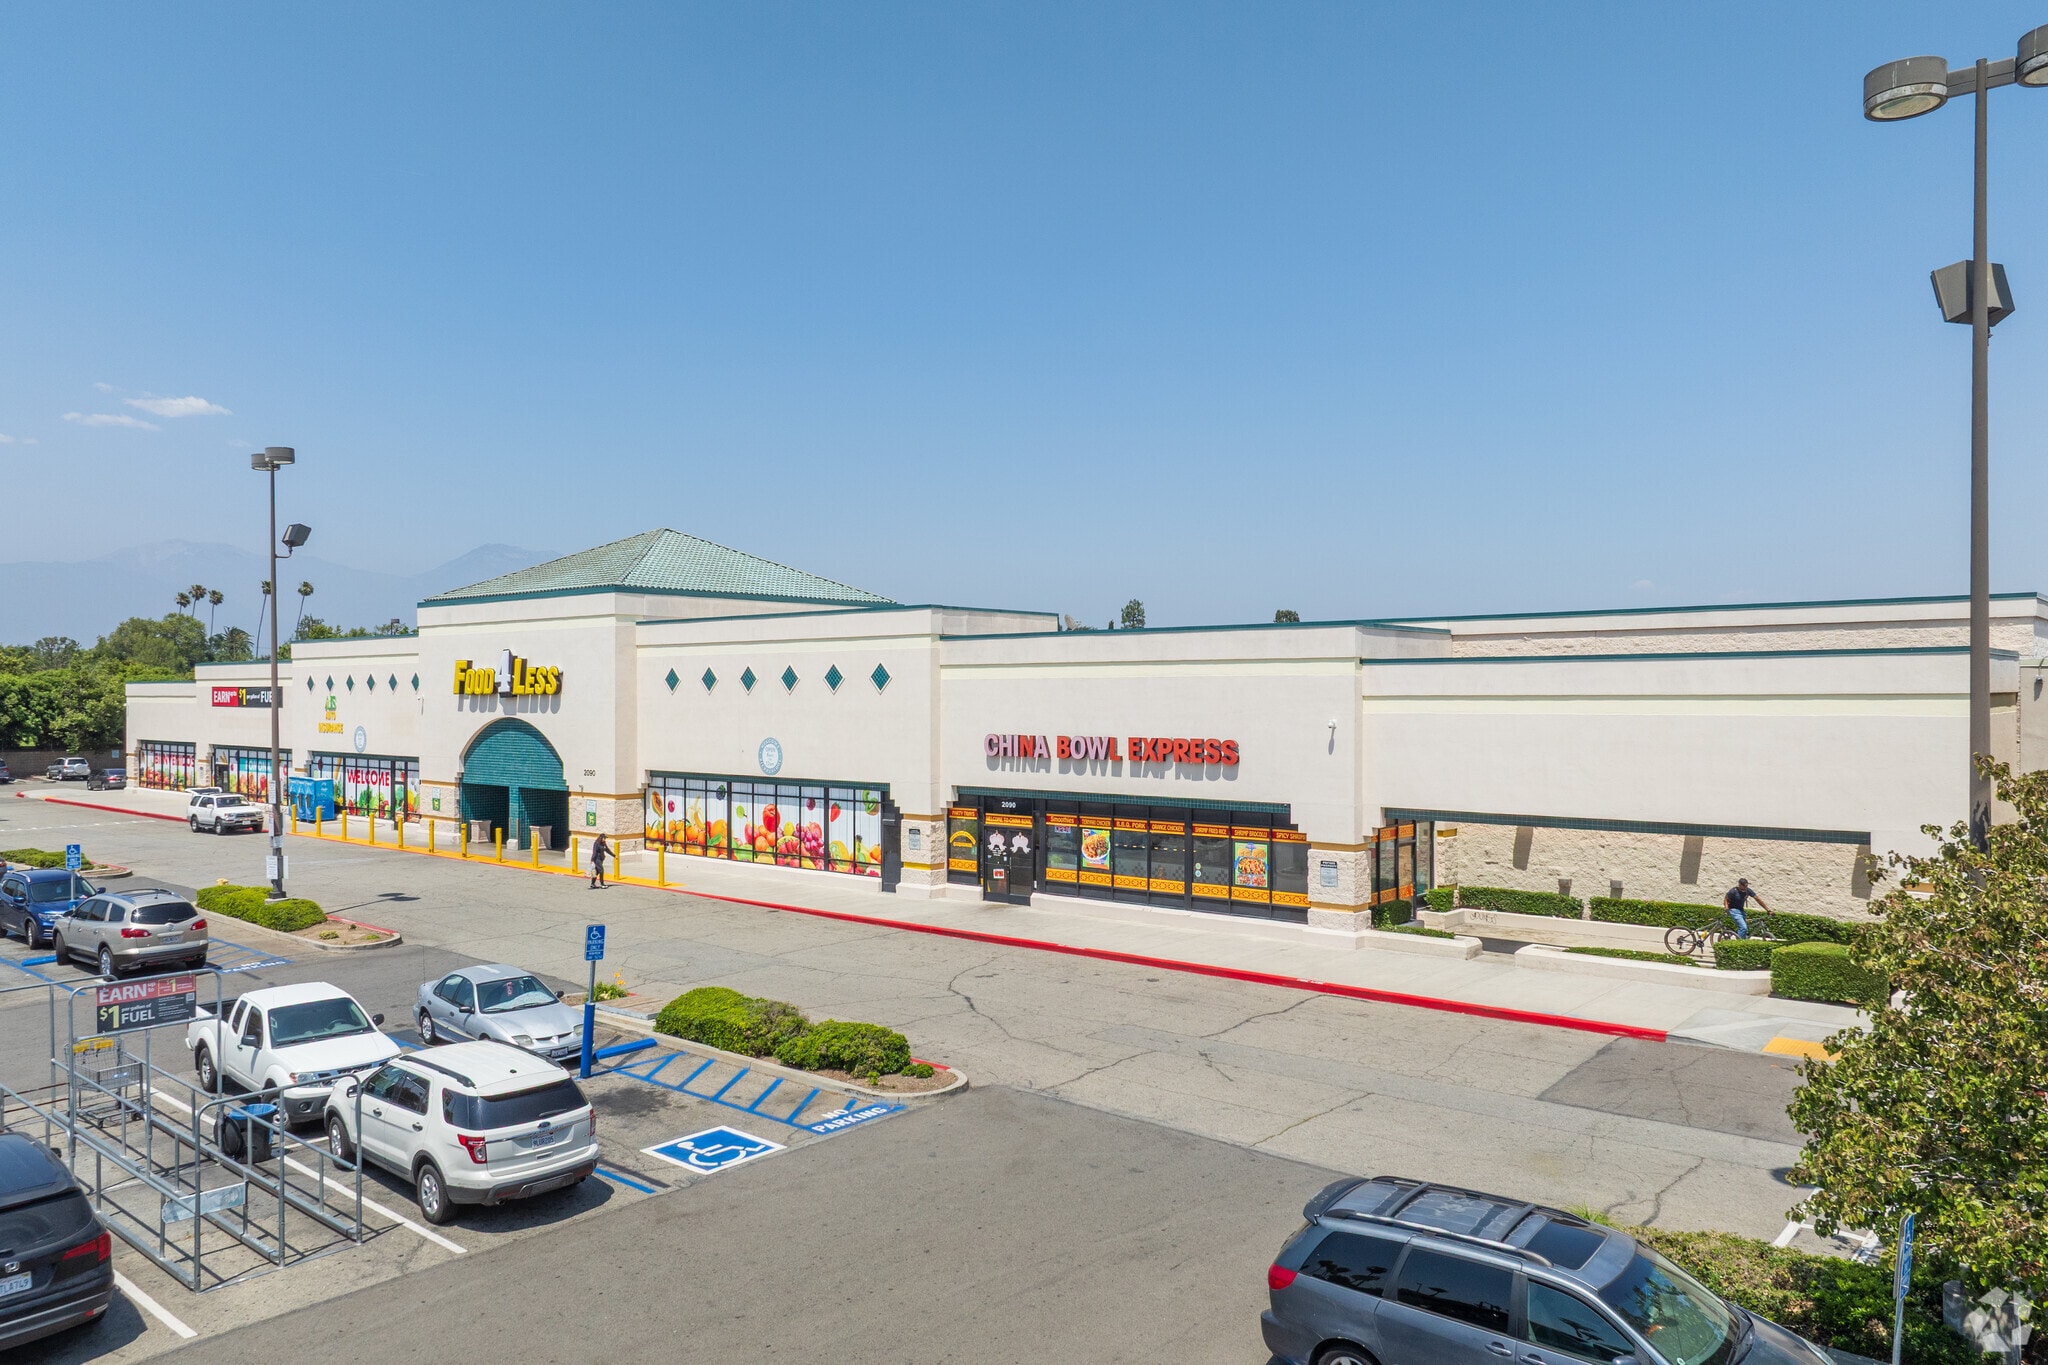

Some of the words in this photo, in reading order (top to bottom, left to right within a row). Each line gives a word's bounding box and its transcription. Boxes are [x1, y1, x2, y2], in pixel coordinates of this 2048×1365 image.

[495, 649, 513, 697] 4
[213, 691, 231, 703] EARN
[239, 688, 246, 705] $1
[260, 691, 272, 702] FUE
[983, 733, 1049, 759] CHINA
[1057, 735, 1123, 761] BOWL
[1128, 737, 1240, 766] EXPRESS
[347, 769, 390, 787] WELCOME
[1050, 815, 1075, 824] Smoothies
[1151, 823, 1166, 831] ORANGE
[1167, 824, 1184, 832] CHICKEN
[99, 983, 147, 1003] EARN
[100, 1005, 119, 1029] $1
[121, 1009, 155, 1024] FUEL
[811, 1107, 887, 1133] PARKING
[821, 1108, 849, 1119] NO
